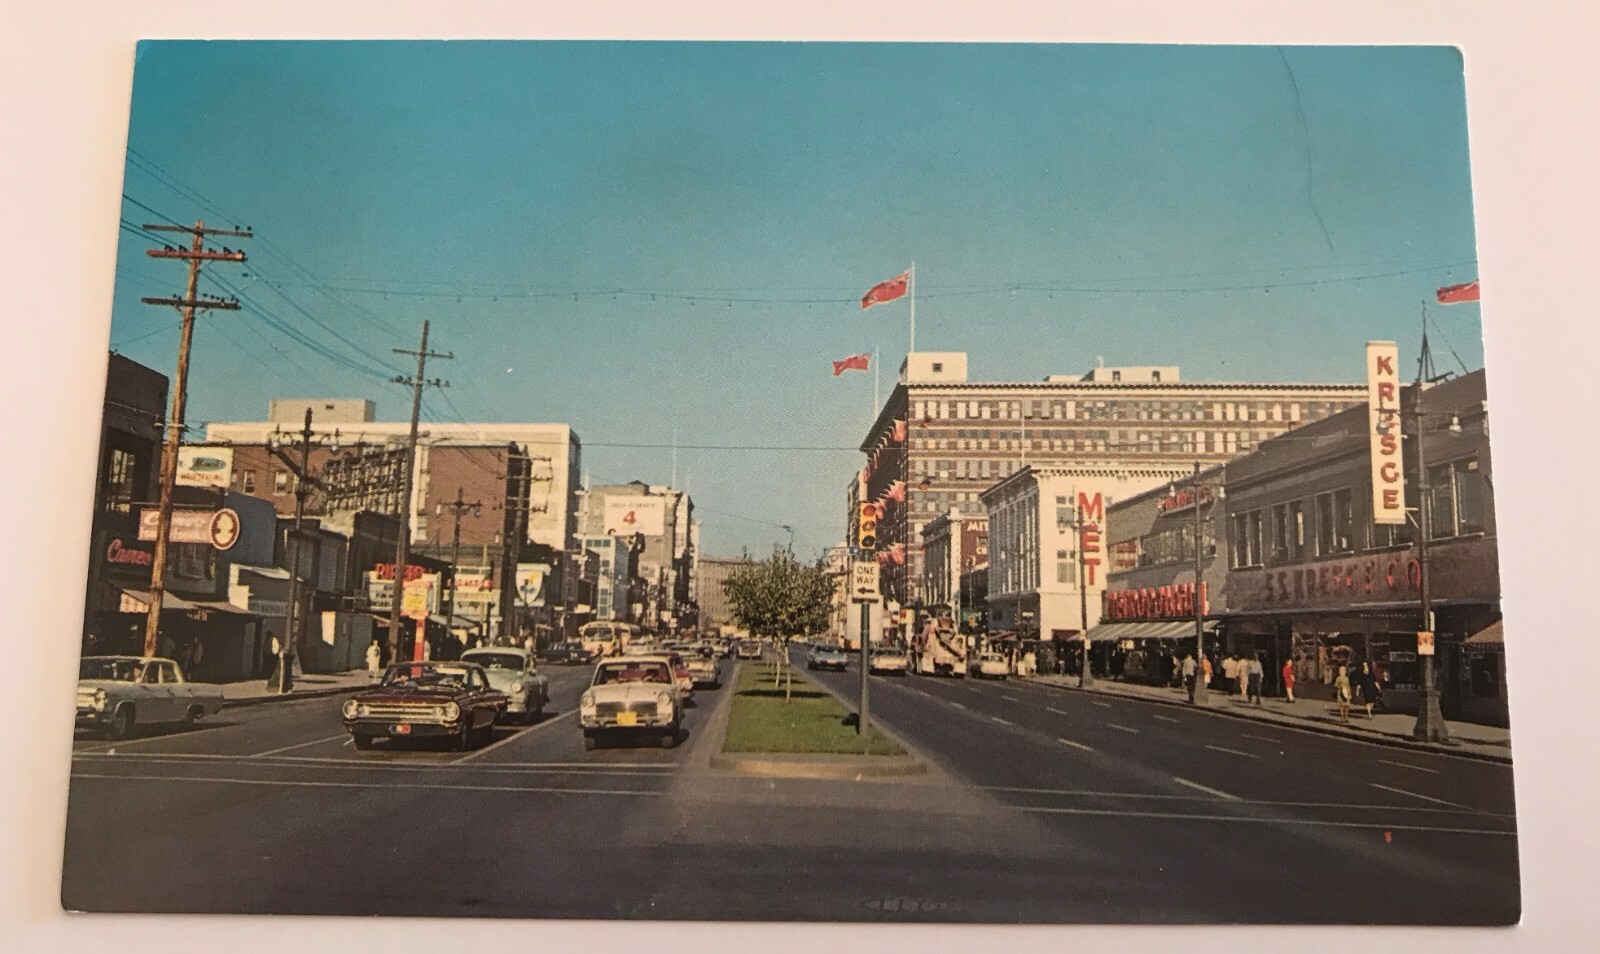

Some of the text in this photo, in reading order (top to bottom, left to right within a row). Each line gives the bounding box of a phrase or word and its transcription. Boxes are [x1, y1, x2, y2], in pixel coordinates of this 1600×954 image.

[623, 510, 637, 525] 4
[1078, 491, 1103, 586] MET
[857, 565, 875, 576] ONE
[857, 576, 875, 585] WAY
